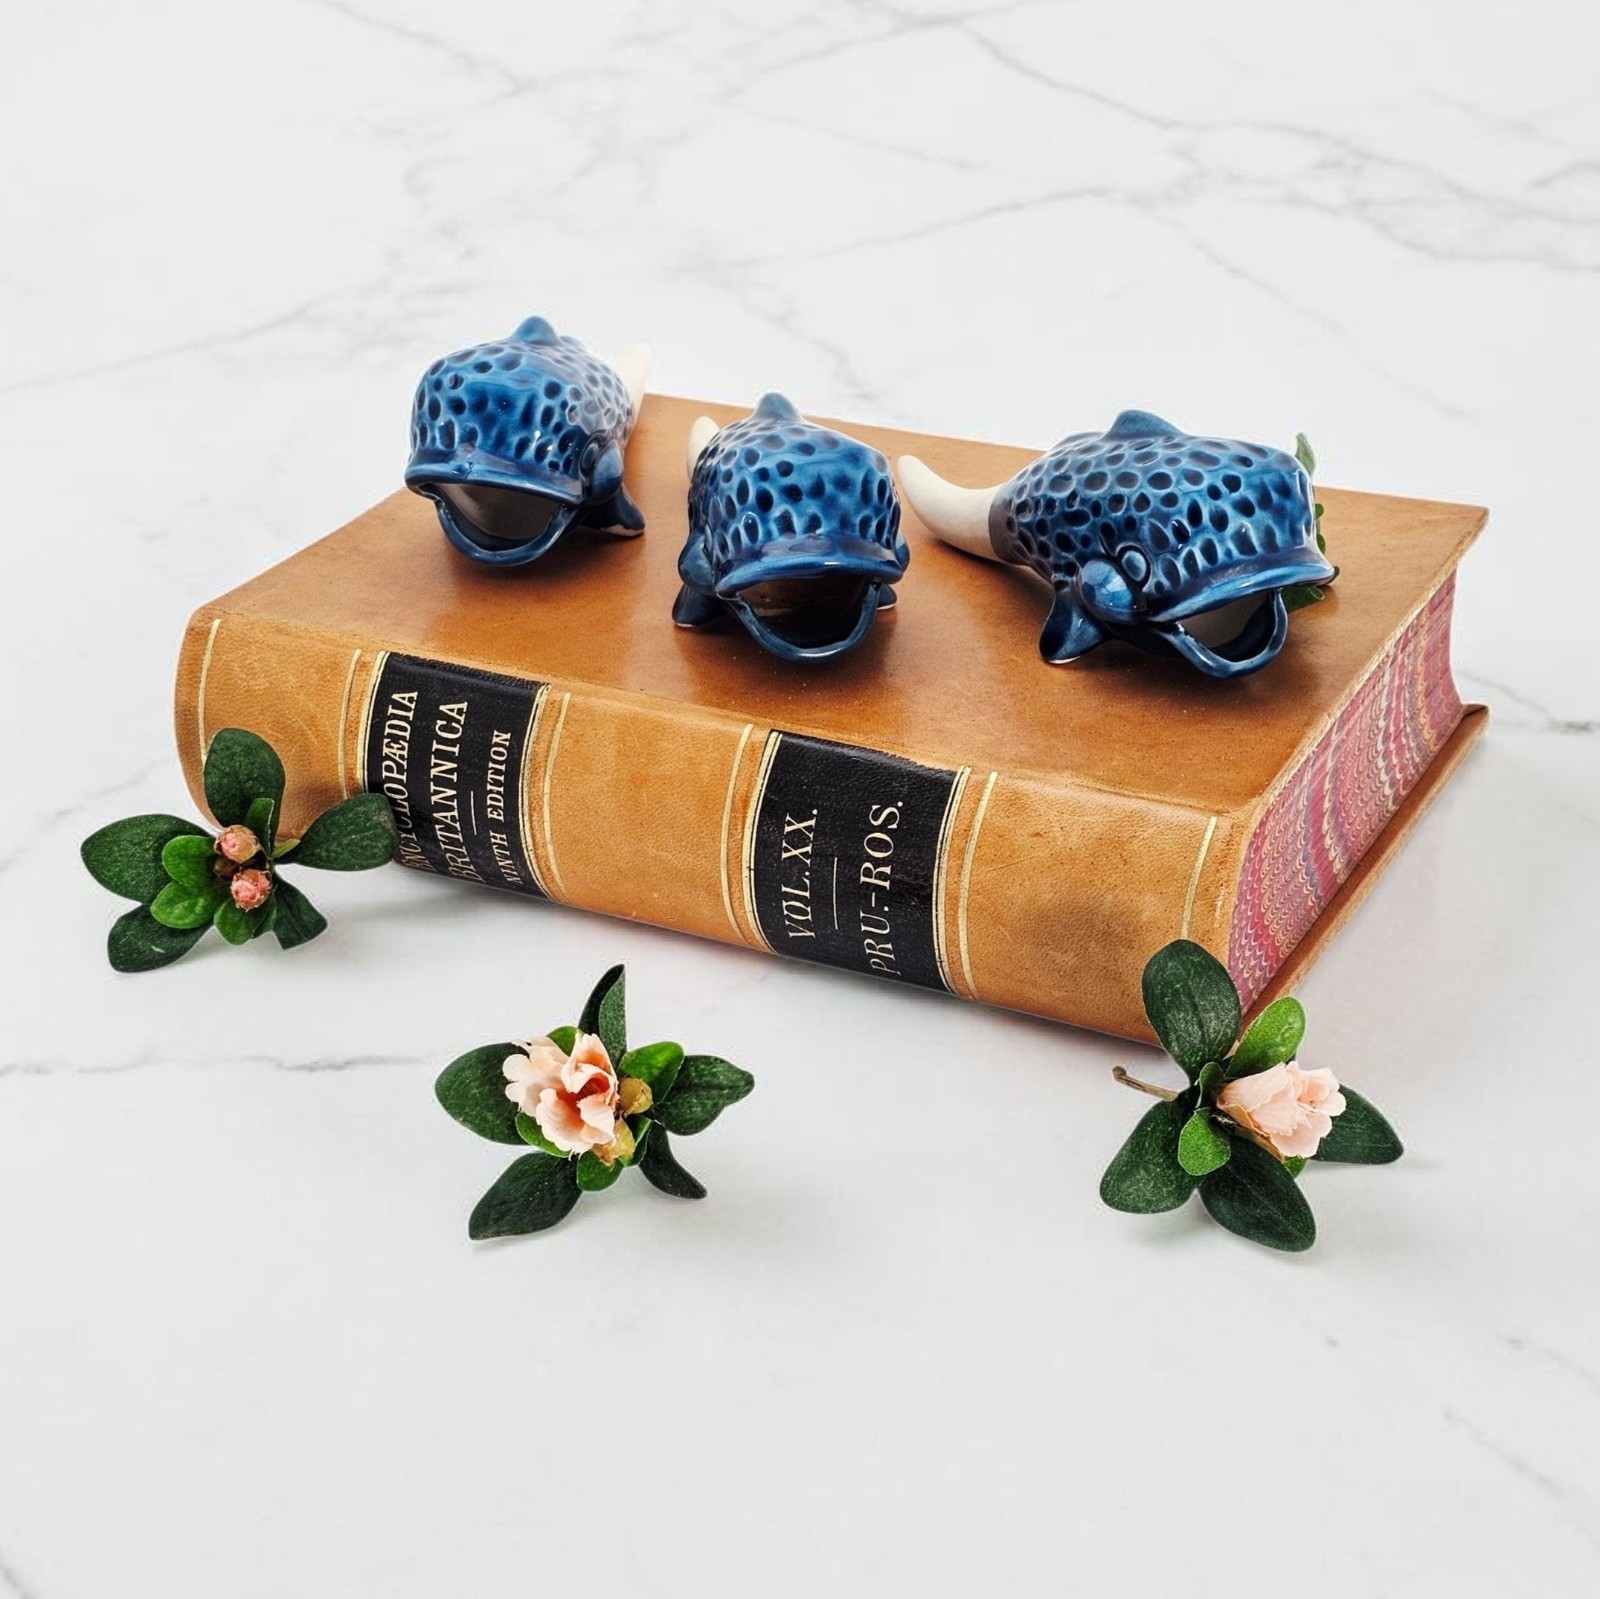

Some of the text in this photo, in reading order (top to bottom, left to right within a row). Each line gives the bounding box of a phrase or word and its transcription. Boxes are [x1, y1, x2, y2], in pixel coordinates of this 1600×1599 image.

[430, 701, 487, 883] BRITANNICA
[486, 729, 524, 885] NINTH EDITION
